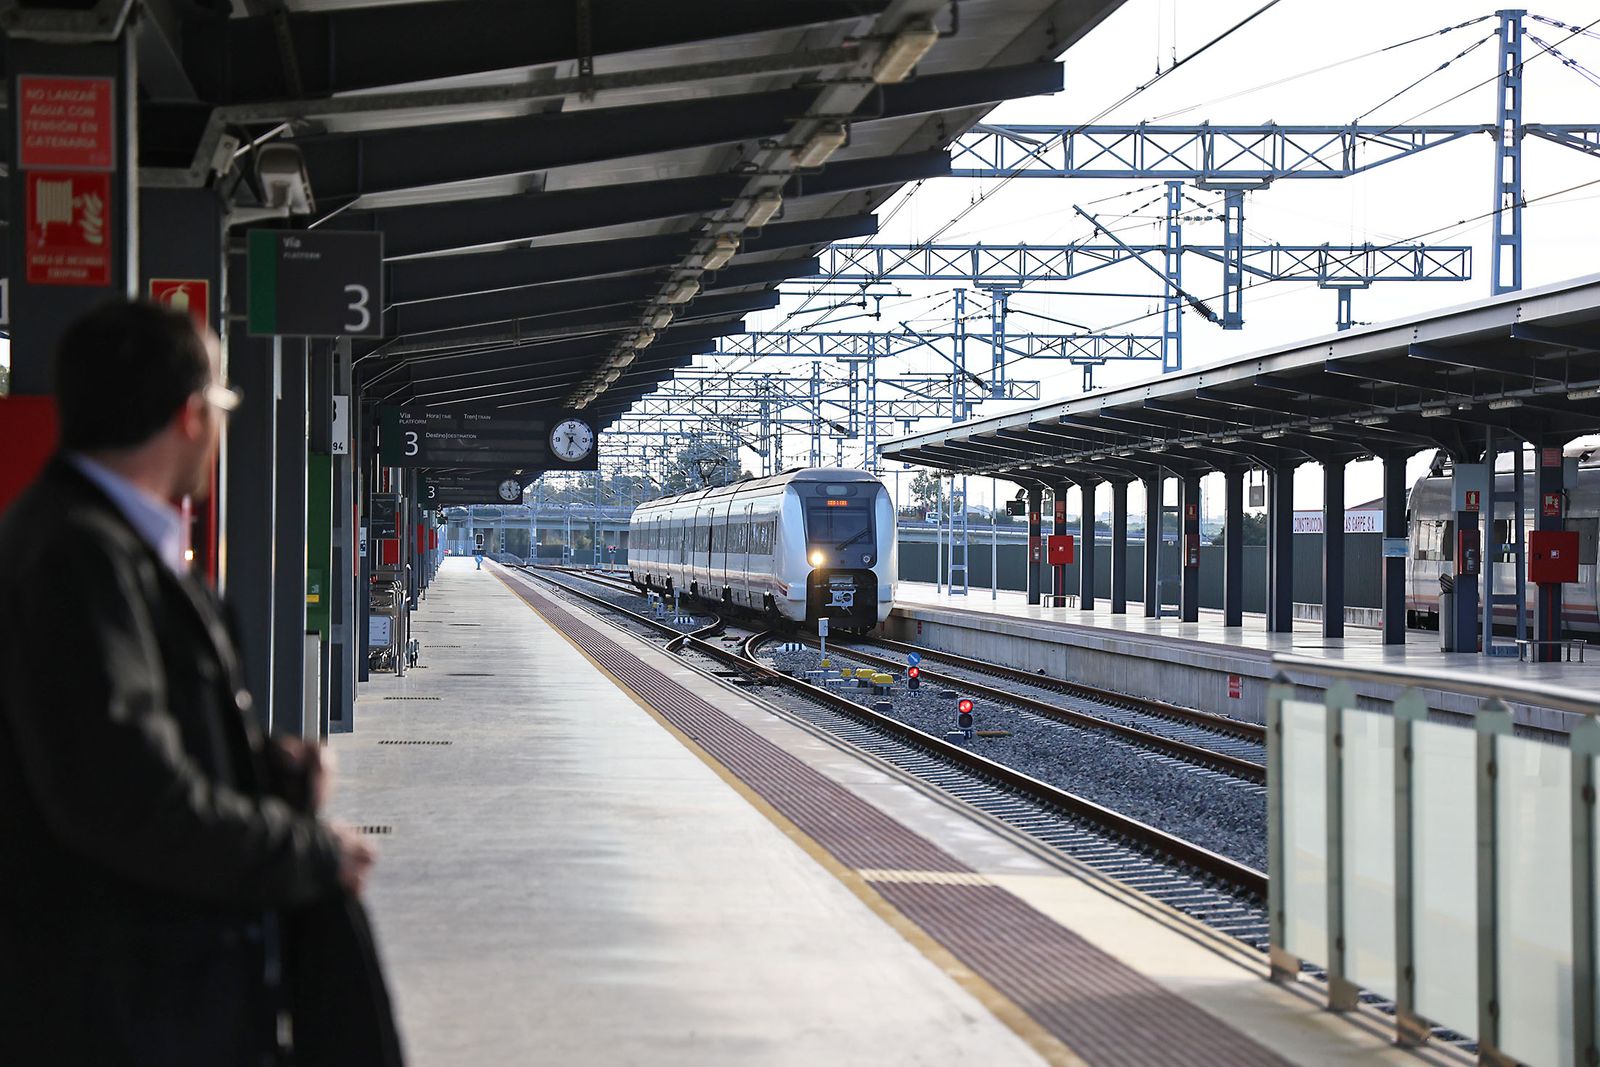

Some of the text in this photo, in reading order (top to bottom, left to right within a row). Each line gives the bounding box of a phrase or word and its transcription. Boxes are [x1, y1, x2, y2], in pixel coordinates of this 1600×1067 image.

[26, 88, 97, 102] NO LANZAR
[30, 104, 96, 118] AGUA CON
[80, 121, 99, 134] EN
[26, 136, 97, 149] CATENARIA
[344, 284, 370, 332] 3
[404, 431, 419, 456] 3
[427, 486, 435, 499] 3
[1007, 507, 1013, 516] 5
